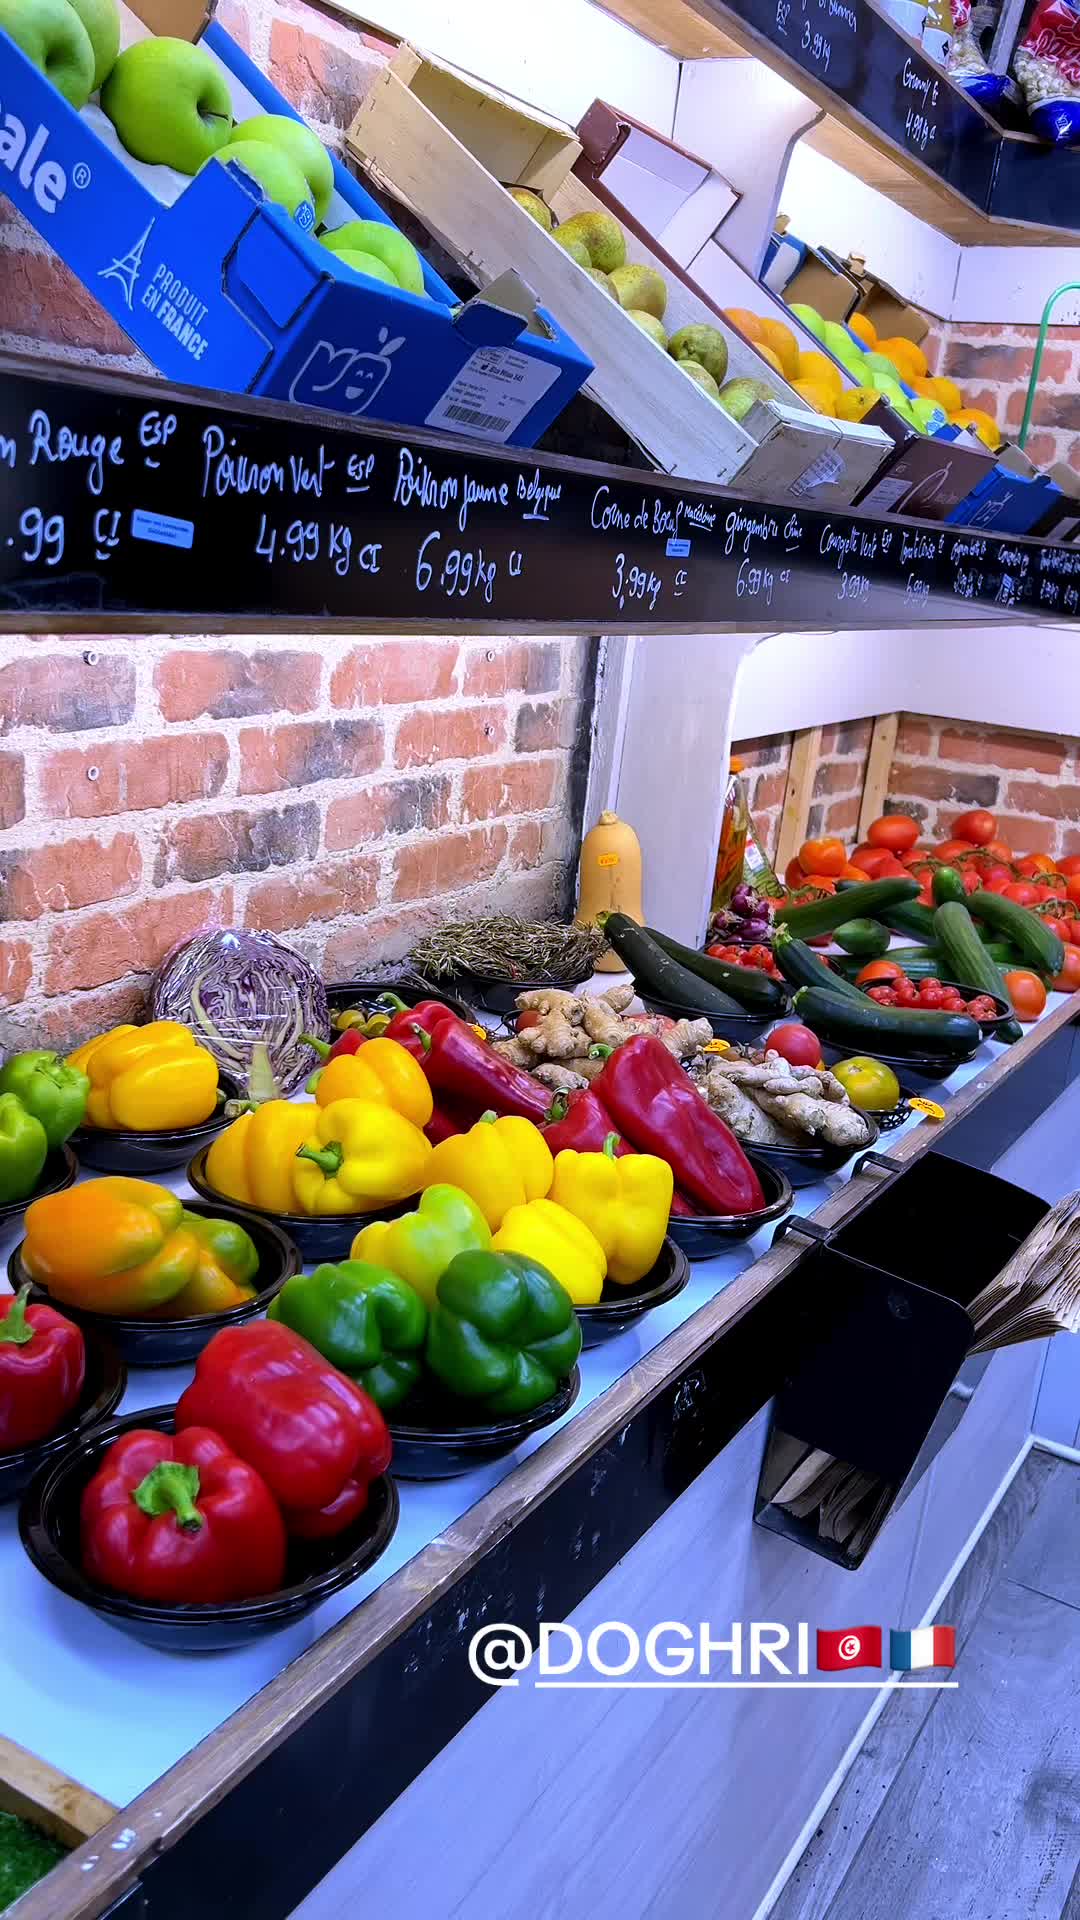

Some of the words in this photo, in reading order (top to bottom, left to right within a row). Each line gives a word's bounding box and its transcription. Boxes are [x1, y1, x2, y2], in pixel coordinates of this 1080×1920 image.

[141, 284, 159, 312] EN
[156, 300, 209, 361] FRANCE
[152, 263, 209, 325] PRODUIT
[28, 408, 125, 495] Rouge
[255, 513, 320, 563] 4.99
[633, 498, 649, 530] de
